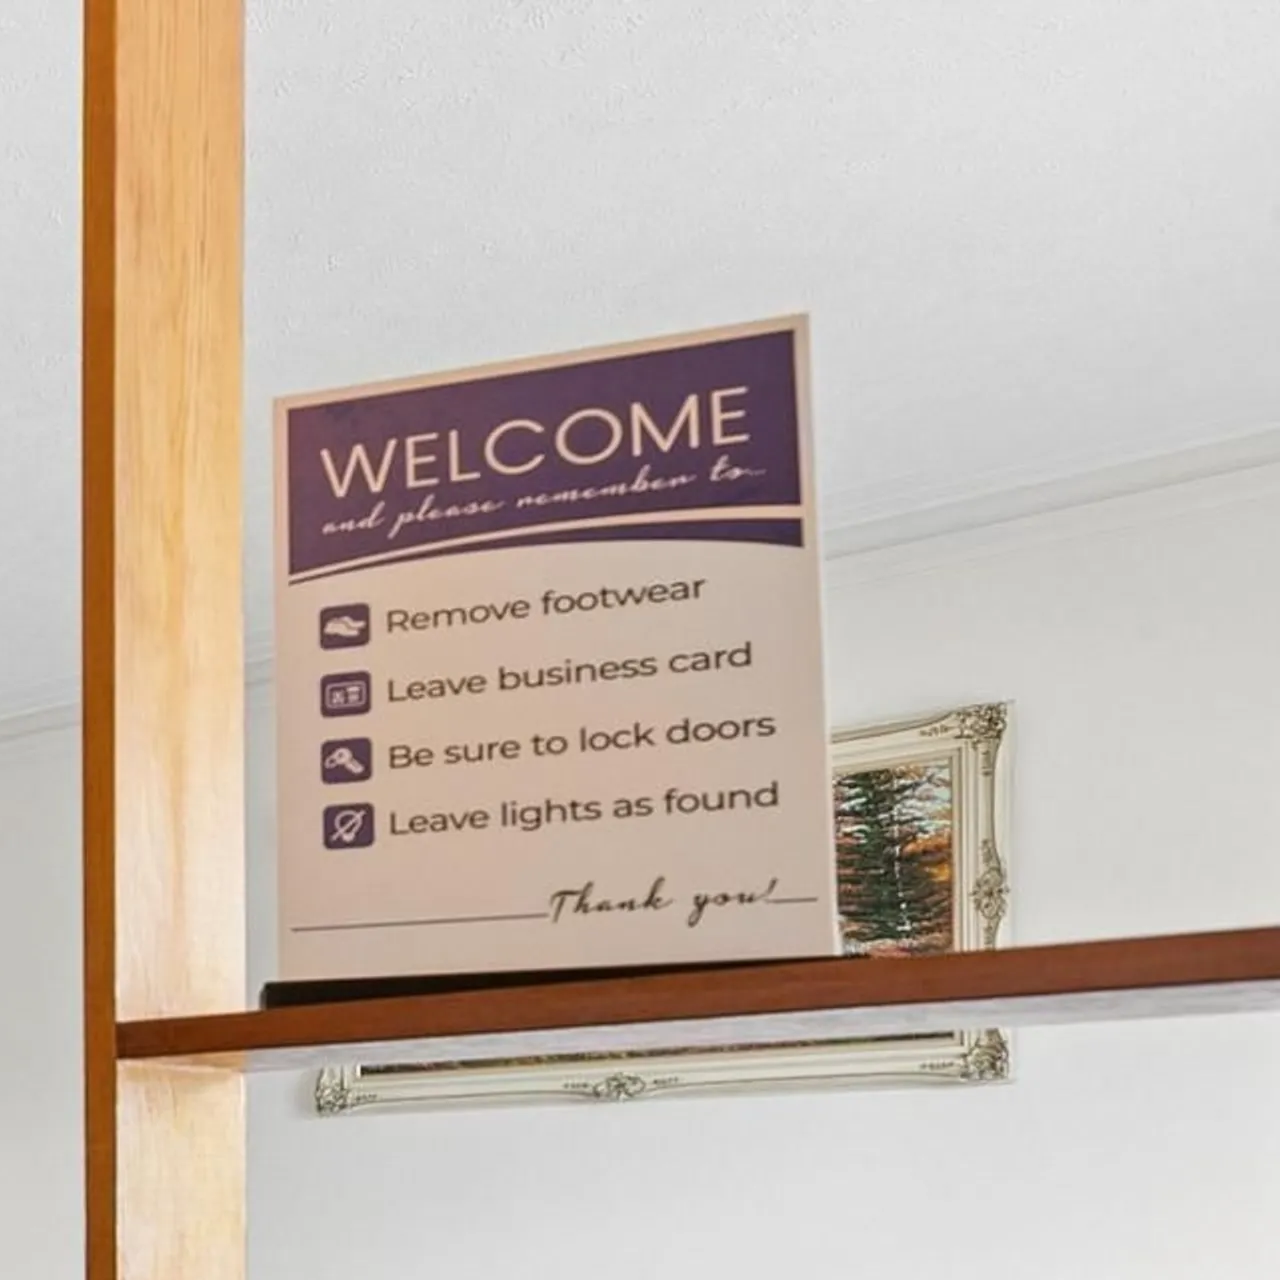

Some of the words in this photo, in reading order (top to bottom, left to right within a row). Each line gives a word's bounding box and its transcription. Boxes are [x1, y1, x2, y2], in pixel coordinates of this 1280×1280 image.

[320, 386, 750, 499] WELCOME
[322, 502, 385, 536] and
[388, 494, 504, 540] please
[516, 465, 696, 509] remember
[387, 598, 531, 634] Remove
[541, 577, 706, 616] footwear
[388, 670, 488, 703] Leave
[498, 652, 658, 691] business
[668, 641, 753, 673] card
[389, 743, 434, 769] Be
[444, 736, 521, 766] sure
[532, 730, 569, 757] to
[580, 719, 656, 752] lock
[666, 712, 776, 745] doors
[389, 808, 490, 835] Leave
[501, 798, 603, 831] lights
[613, 794, 653, 818] as
[664, 780, 779, 815] found
[550, 877, 671, 923] Thank
[688, 877, 778, 928] you!
